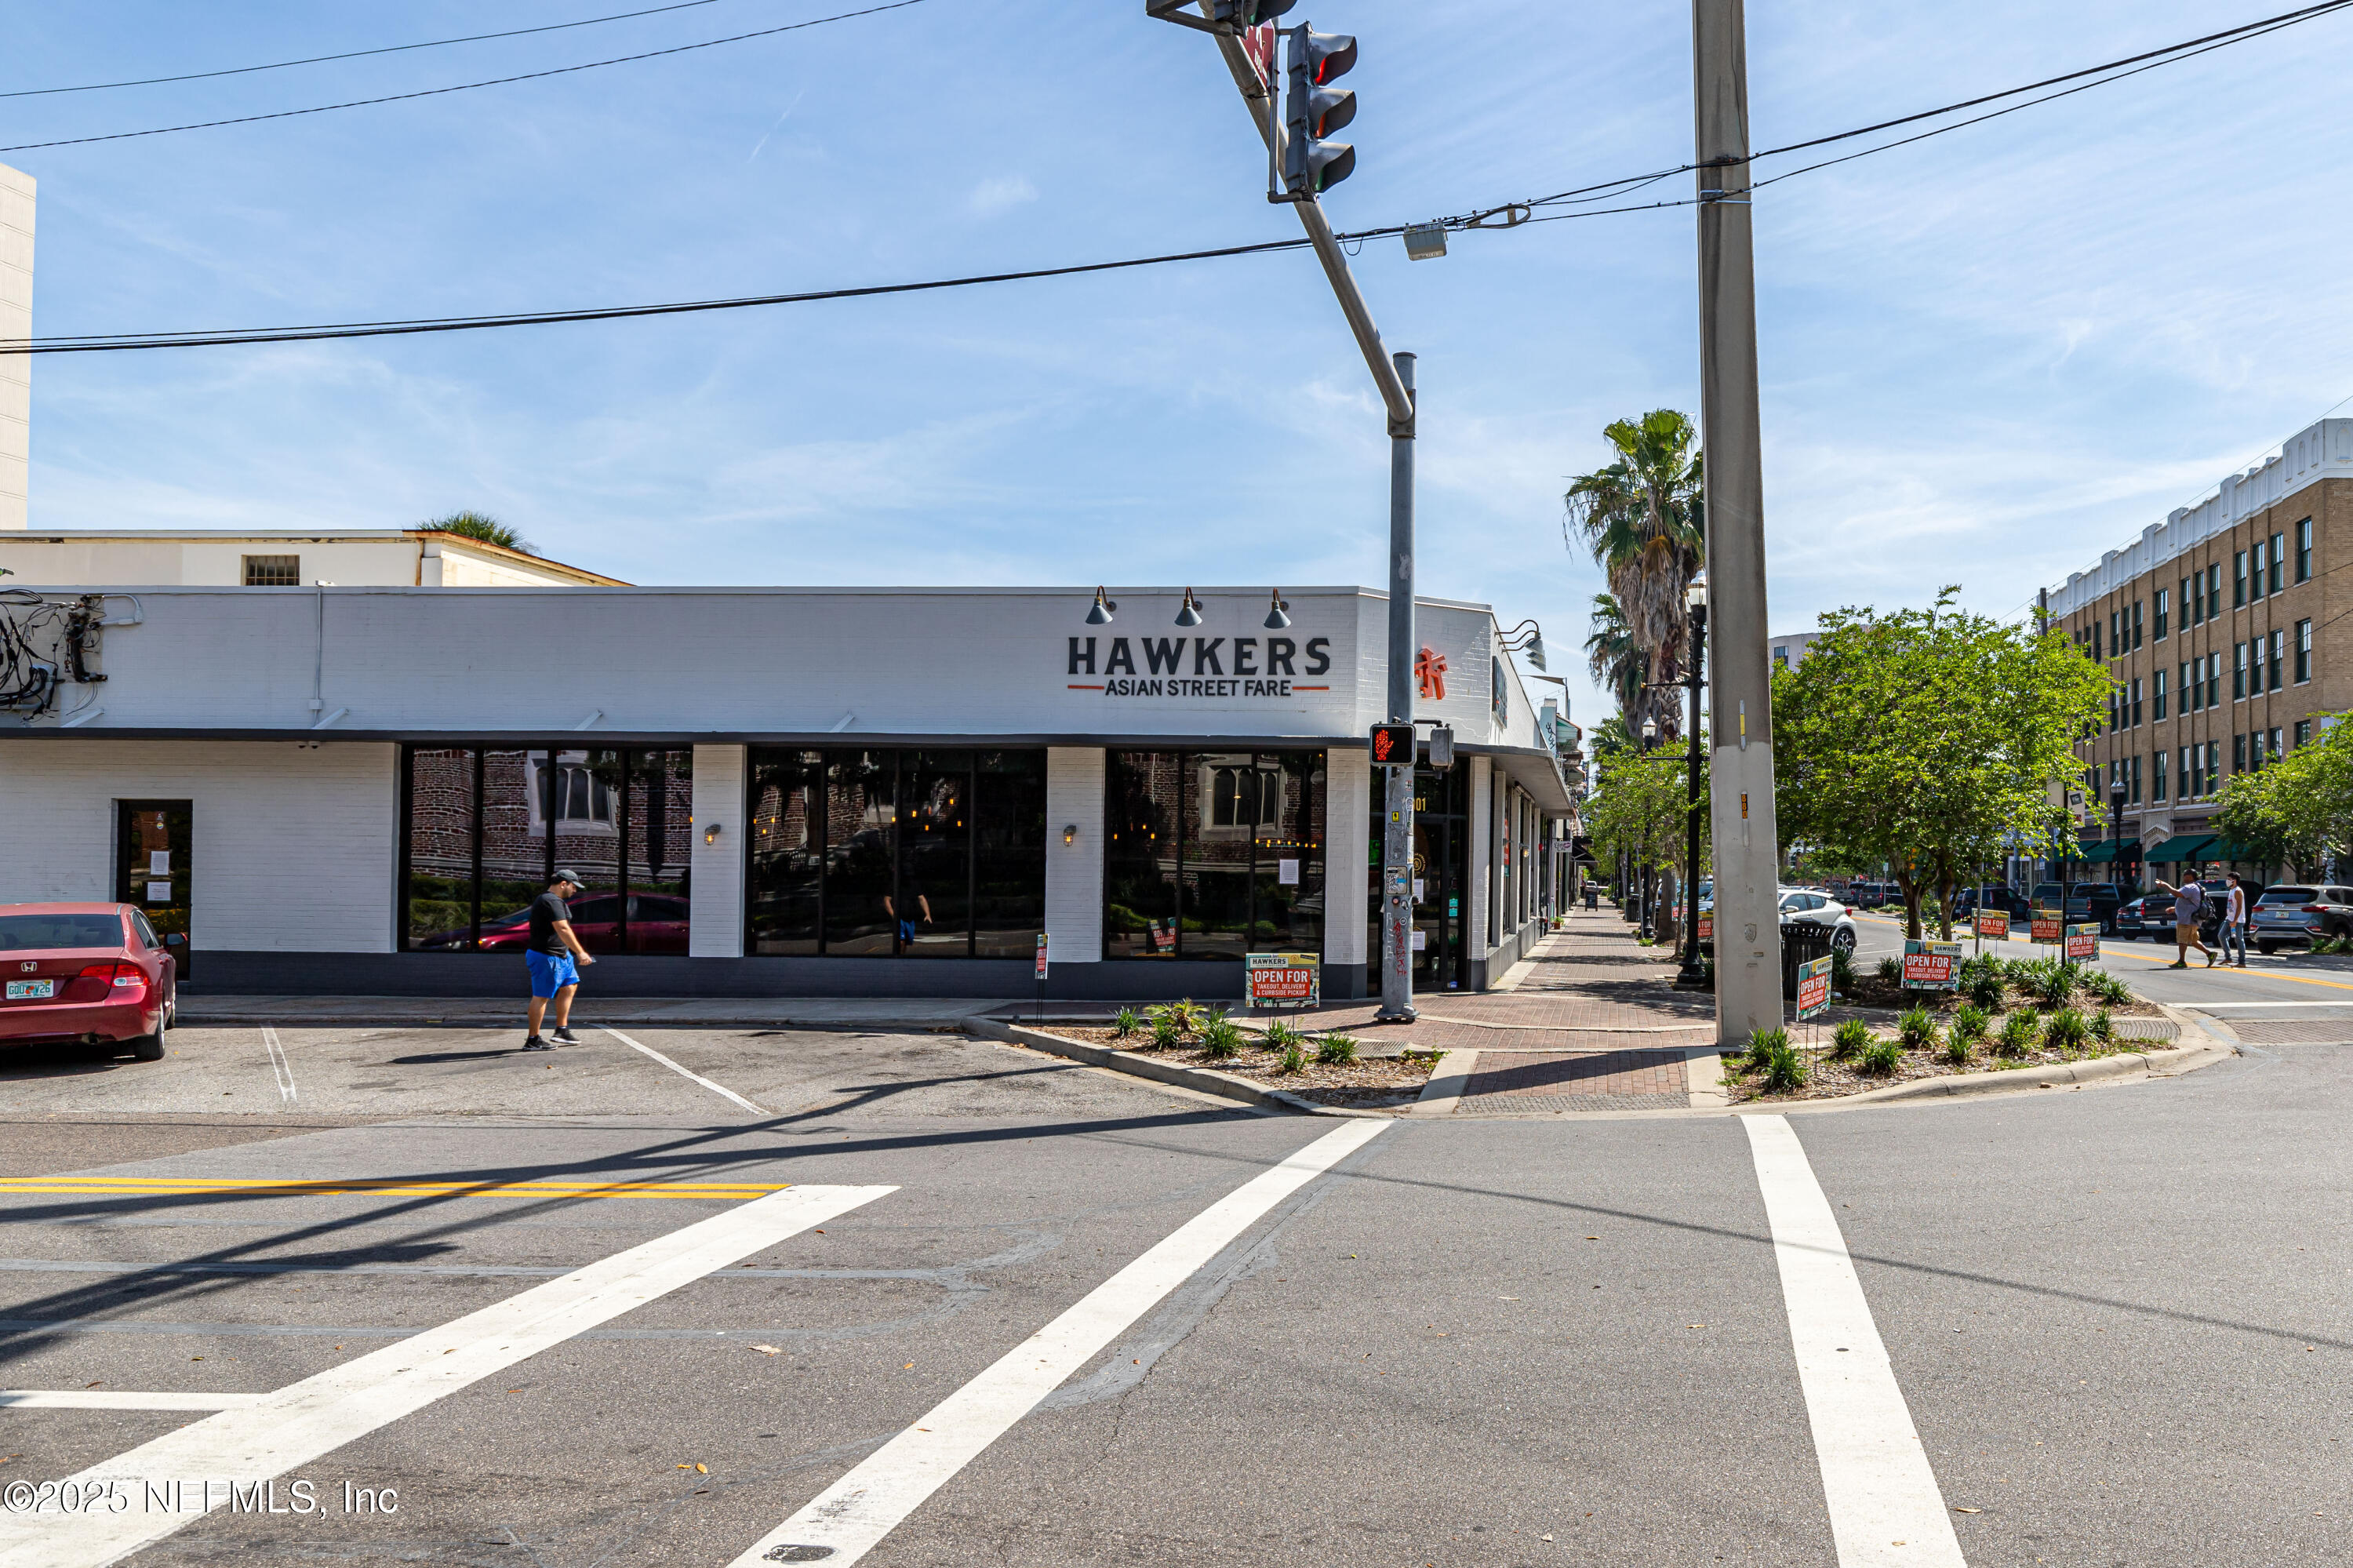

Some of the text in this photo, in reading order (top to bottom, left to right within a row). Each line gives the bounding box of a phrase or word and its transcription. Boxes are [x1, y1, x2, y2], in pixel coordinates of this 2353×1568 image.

[1067, 637, 1330, 675] HAWKERS
[1105, 680, 1291, 697] ASIAN STREET FARE
[1413, 797, 1426, 811] 01
[2047, 921, 2058, 930] FOR
[2069, 936, 2093, 946] OPEN FOR
[1907, 955, 1949, 968] OPEN FOR
[1255, 971, 1307, 982] OPEN FOR
[1801, 976, 1825, 995] OPEN FOR
